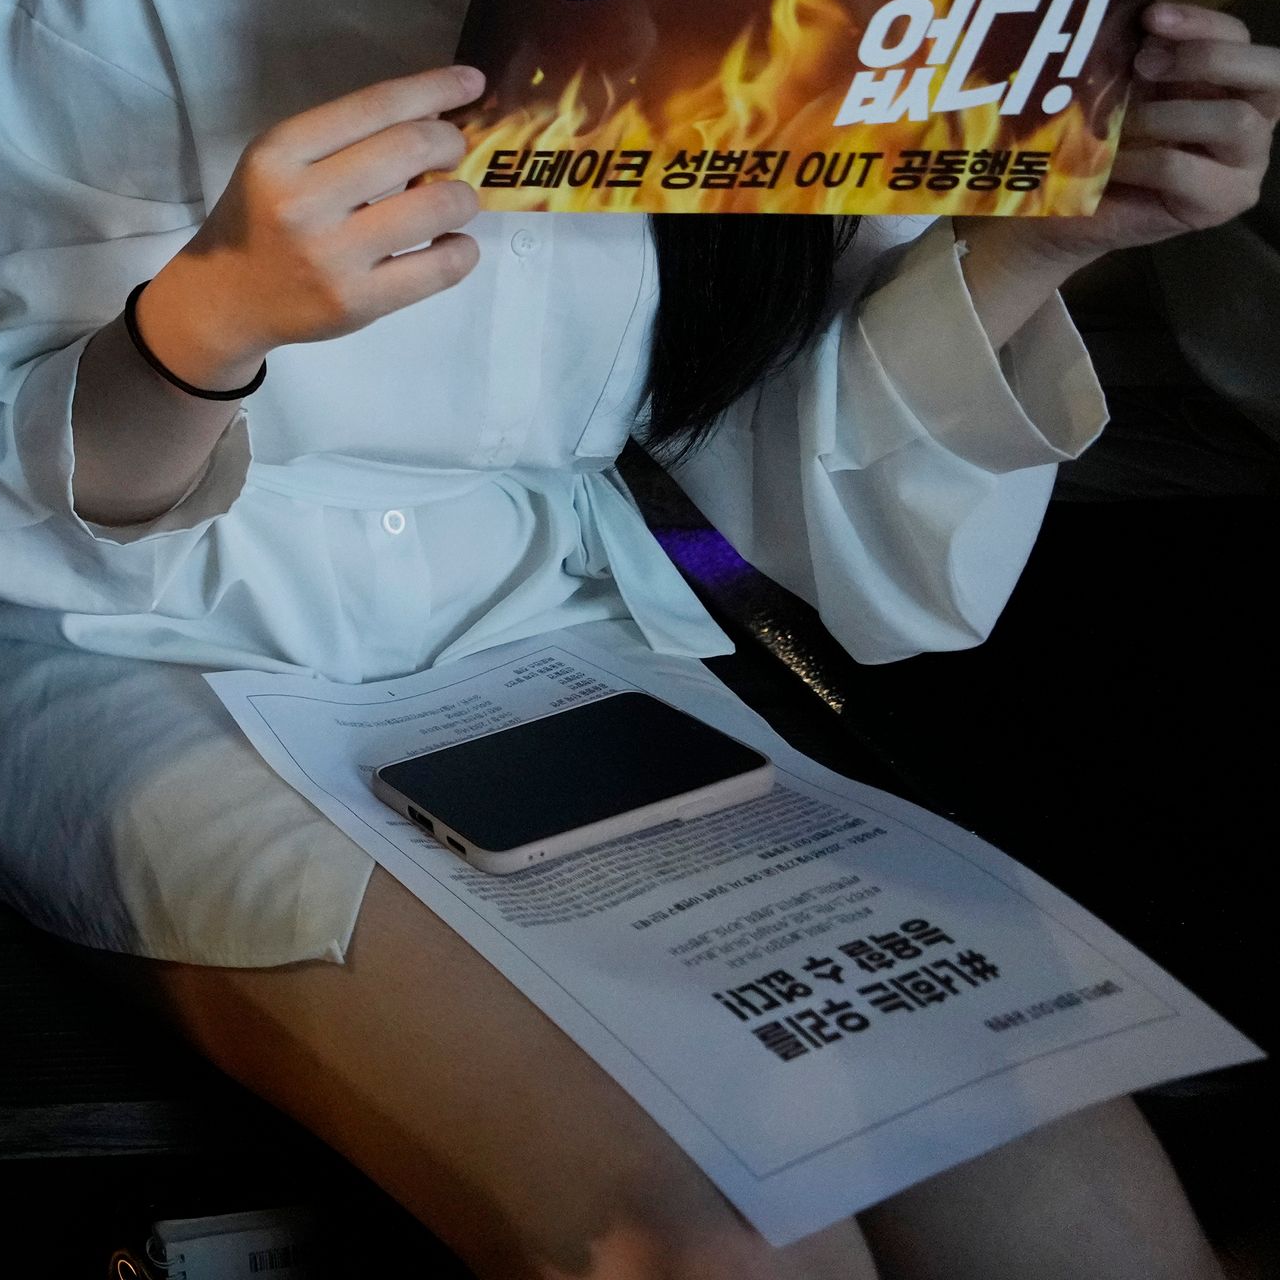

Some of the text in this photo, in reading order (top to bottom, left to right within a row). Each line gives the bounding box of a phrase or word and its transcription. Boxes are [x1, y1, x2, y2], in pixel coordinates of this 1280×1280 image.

[479, 150, 1050, 191] 딥페이크 성범죄 OUT 공동행동
[711, 918, 956, 1021] 능욕할 수 없다!
[751, 949, 1001, 1062] #너희는 우리를
